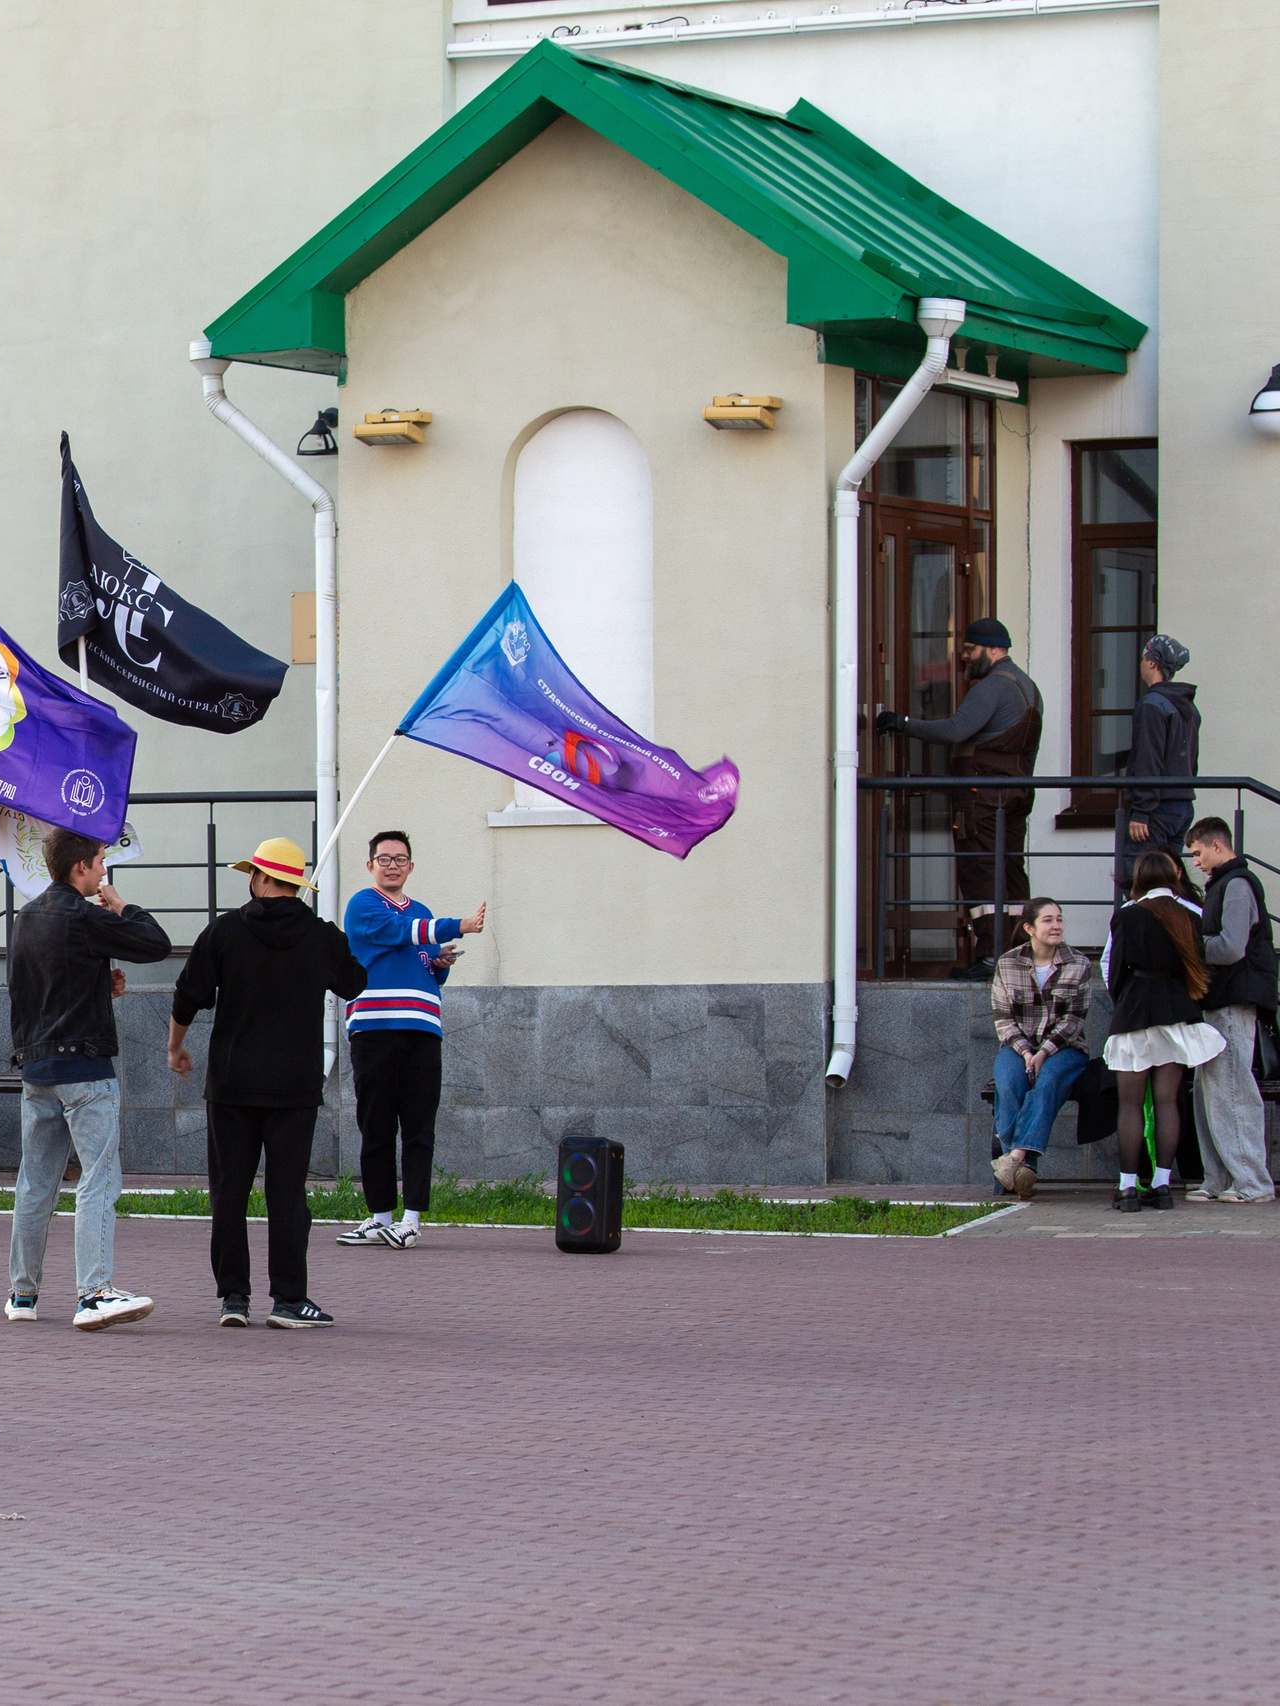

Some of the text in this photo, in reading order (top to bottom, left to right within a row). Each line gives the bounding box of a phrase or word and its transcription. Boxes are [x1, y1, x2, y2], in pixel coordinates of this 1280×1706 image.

[116, 664, 176, 703] СЕРВИСНЫЙ
[178, 698, 219, 714] ОТРЯД
[537, 679, 681, 780] студенческий сервисный отряд
[528, 756, 581, 791] СВОИ
